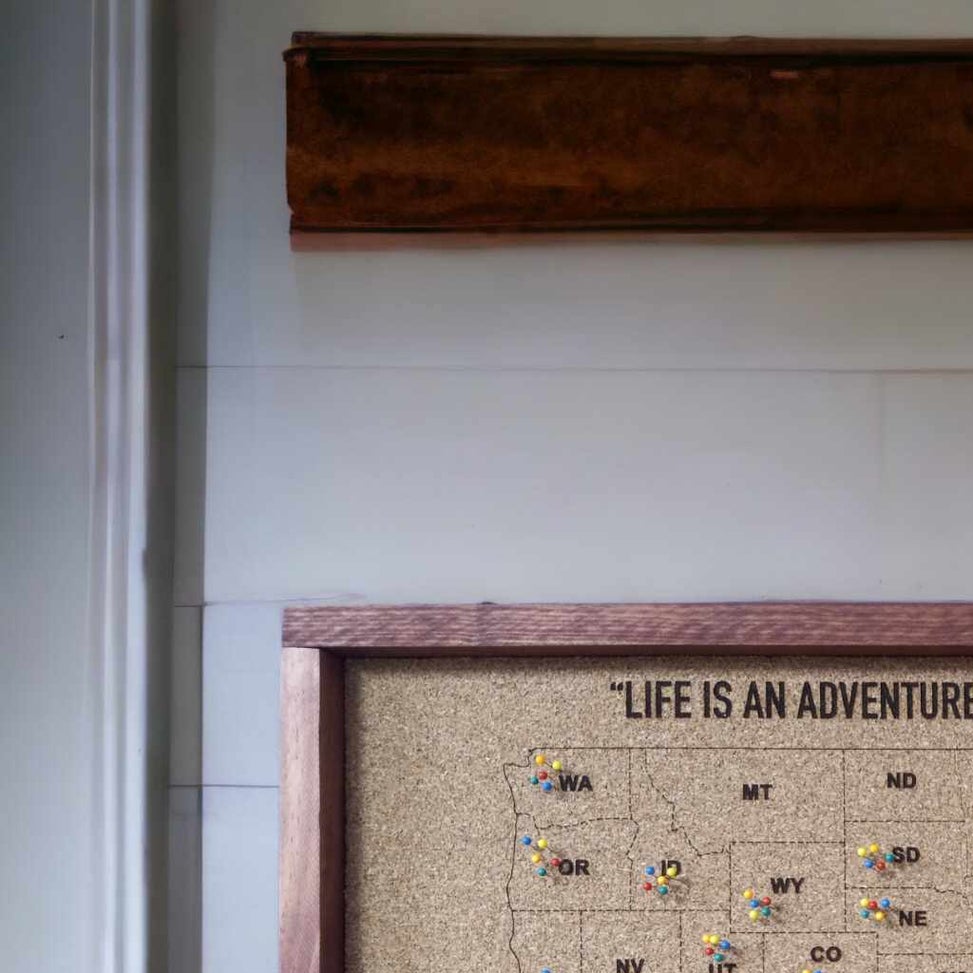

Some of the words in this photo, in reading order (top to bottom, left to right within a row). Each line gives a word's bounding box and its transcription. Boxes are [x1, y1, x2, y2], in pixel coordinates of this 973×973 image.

[703, 680, 733, 719] IS
[742, 681, 786, 719] AN
[558, 774, 593, 792] WA
[886, 772, 917, 789] ND
[742, 784, 773, 801] MT
[892, 846, 920, 865] SD
[558, 859, 590, 876] OR
[661, 859, 682, 879] ID
[770, 877, 804, 894] WY
[899, 910, 927, 927] NE
[810, 946, 842, 963] CO
